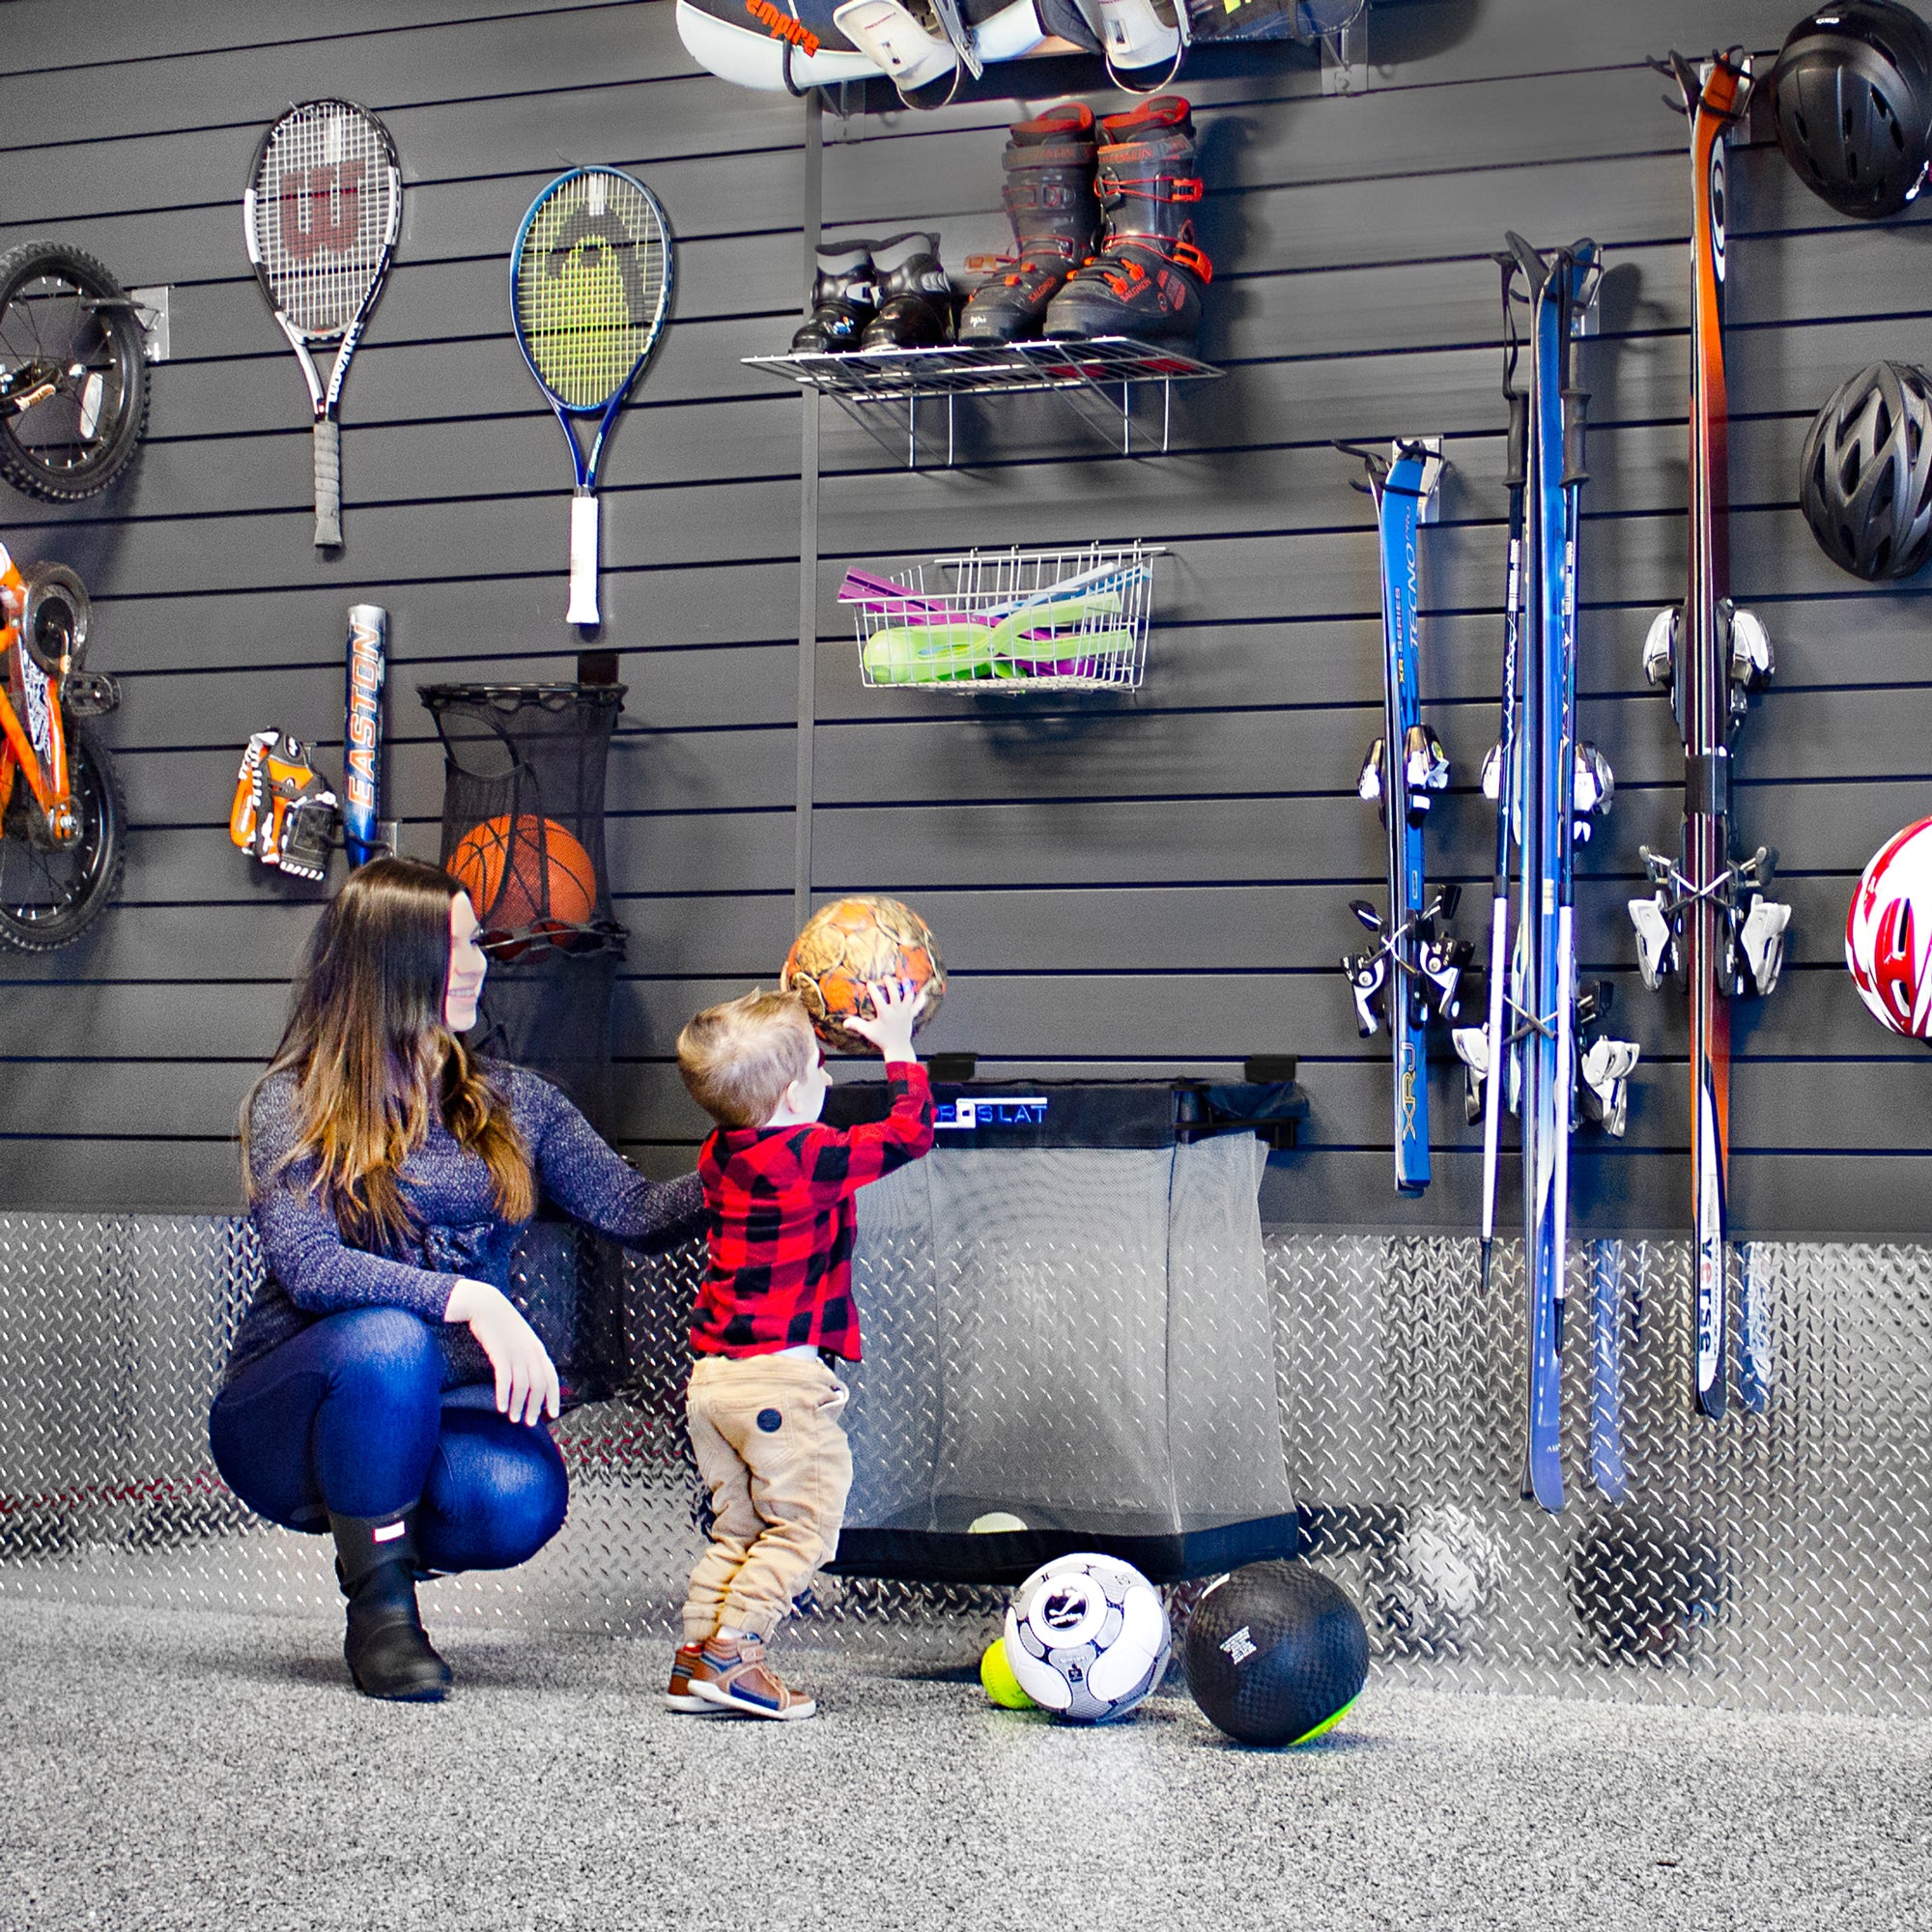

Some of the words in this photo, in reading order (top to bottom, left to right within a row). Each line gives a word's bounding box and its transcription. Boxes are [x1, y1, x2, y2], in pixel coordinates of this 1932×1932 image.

[745, 0, 820, 58] empire
[348, 622, 380, 810] EASTON
[935, 1097, 1048, 1129] ROSLAT
[1400, 1040, 1417, 1142] XRJ
[1699, 1236, 1714, 1353] verse
